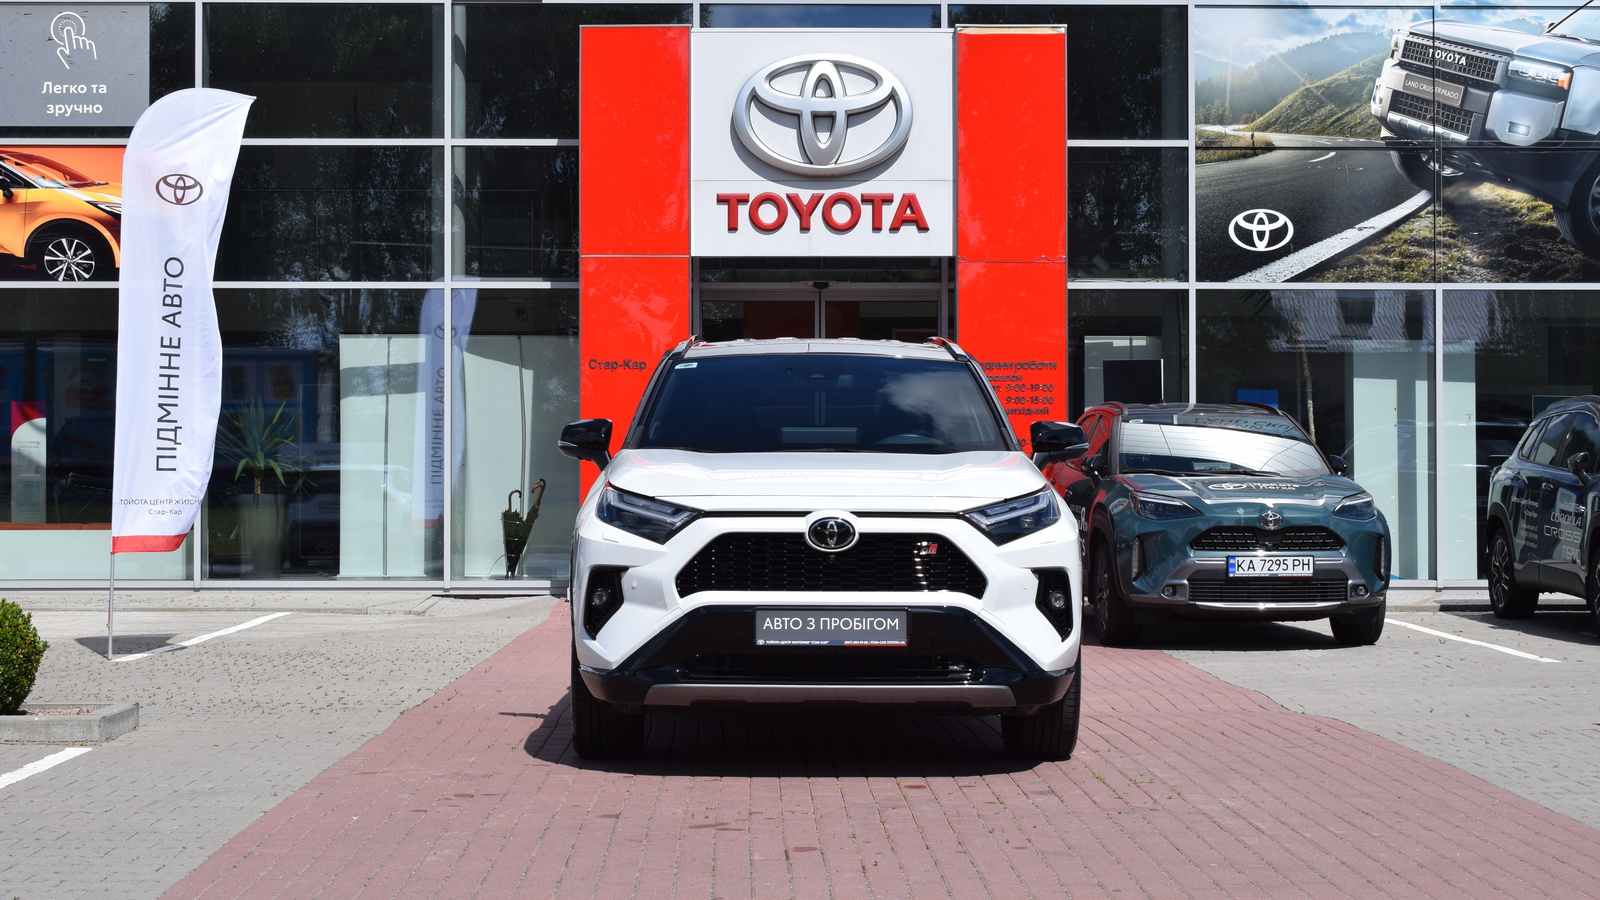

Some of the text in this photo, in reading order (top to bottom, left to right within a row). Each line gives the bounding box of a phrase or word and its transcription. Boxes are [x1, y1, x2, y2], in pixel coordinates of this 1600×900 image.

[1429, 49, 1466, 66] TOYOTA
[42, 81, 107, 94] Легко та
[1405, 80, 1459, 100] LAND CRUISER PRADO
[46, 104, 103, 117] зручно
[716, 192, 930, 231] TOYOTA
[156, 257, 184, 472] ПІДМІННЕ АВТО
[588, 359, 647, 371] Стар-Кар
[978, 359, 1057, 372] одини роботи
[1005, 383, 1054, 392] 9:00-19:00
[1005, 407, 1049, 415] вихідний
[120, 498, 148, 506] ТОЙОТА
[148, 508, 182, 516] Стар-Кар
[1551, 512, 1581, 526] COROLLA
[1543, 525, 1581, 544] CROSS
[1260, 559, 1289, 572] 7295
[763, 617, 899, 631] АВТО З ПРОБІГОМ
